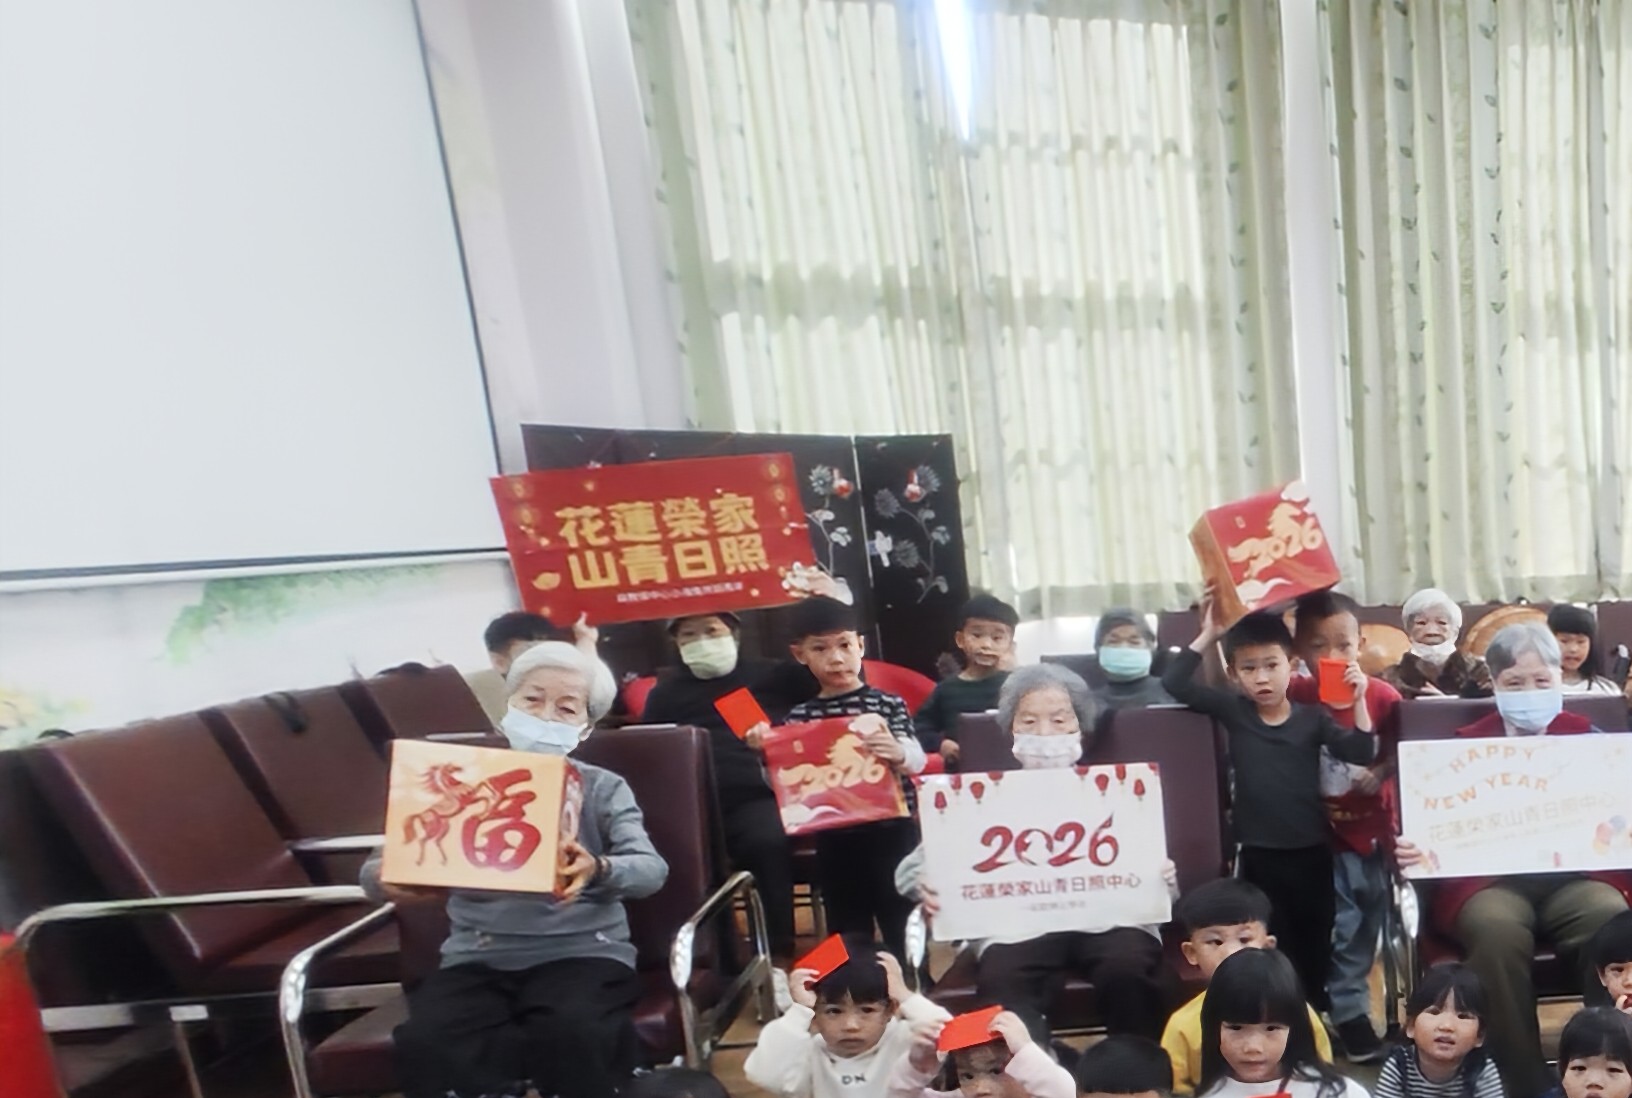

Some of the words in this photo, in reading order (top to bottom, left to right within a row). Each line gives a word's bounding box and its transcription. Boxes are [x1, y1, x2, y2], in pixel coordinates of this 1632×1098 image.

[555, 493, 759, 548] 花蓮榮家
[567, 533, 770, 590] 山青日照
[1449, 744, 1535, 775] HAPPY
[1423, 785, 1478, 811] NEW
[1485, 772, 1550, 792] YEAR
[462, 768, 542, 872] 福
[971, 812, 1120, 874] 2026
